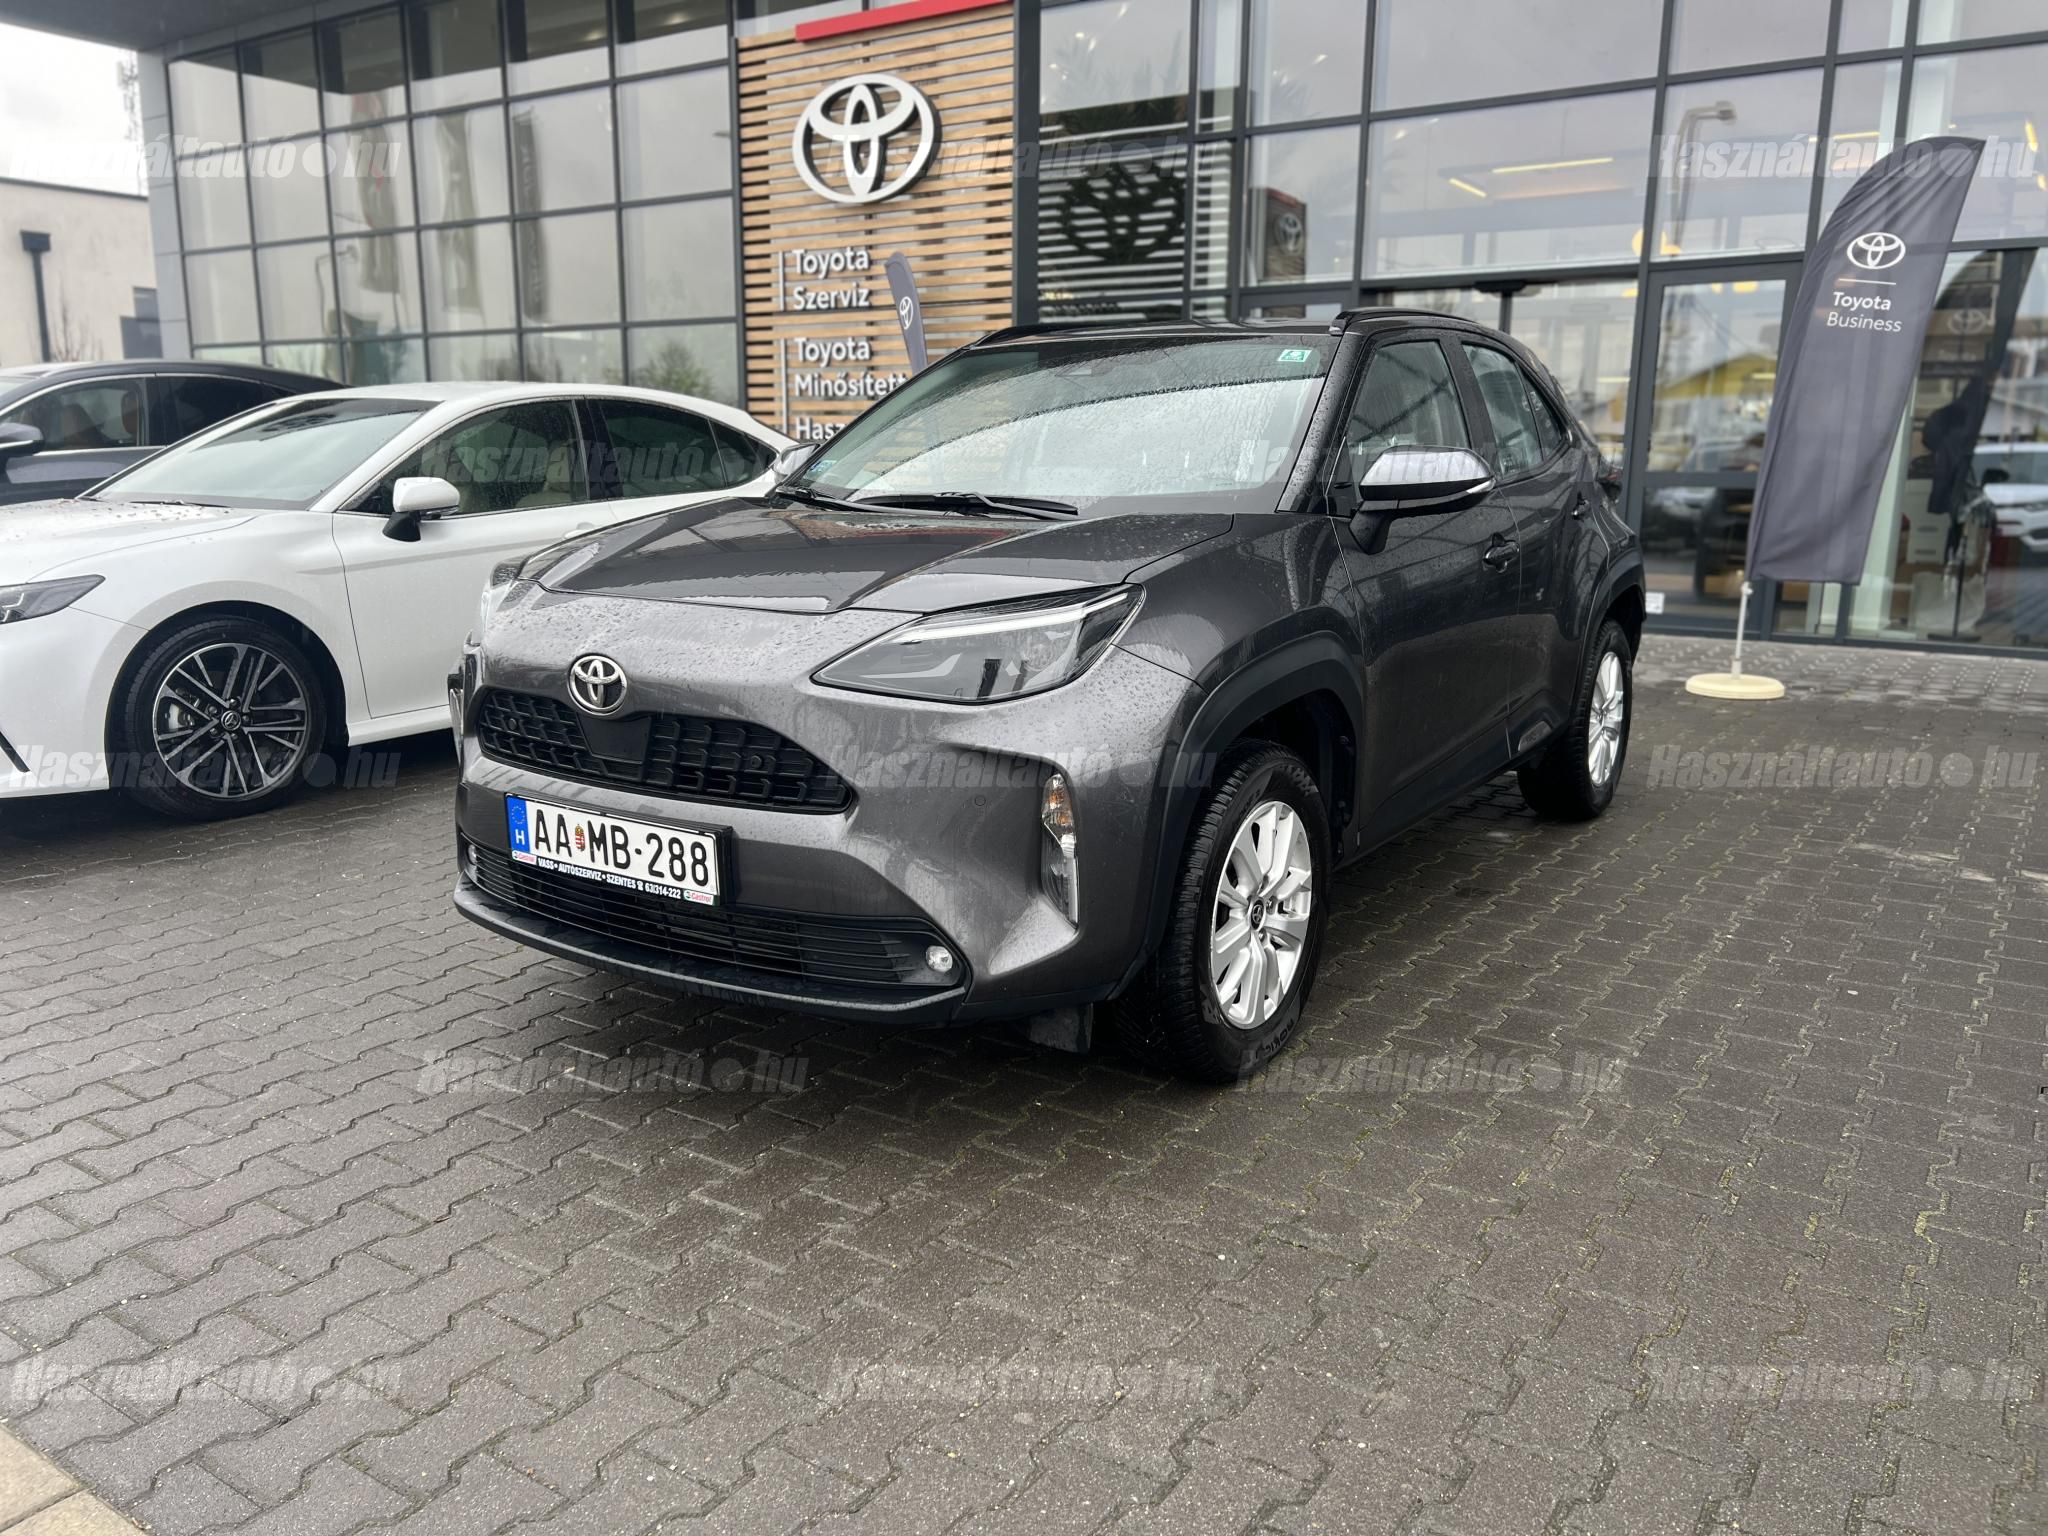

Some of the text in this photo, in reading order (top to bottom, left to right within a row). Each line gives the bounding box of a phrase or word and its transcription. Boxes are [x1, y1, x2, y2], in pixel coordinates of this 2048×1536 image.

[792, 247, 869, 279] Toyota
[793, 282, 870, 310] Szerviz
[1833, 291, 1891, 311] Toyota
[1827, 311, 1902, 332] Business
[794, 337, 870, 367] Toyota
[515, 829, 526, 846] H
[538, 857, 555, 870] VASS
[606, 873, 636, 889] SZENTES
